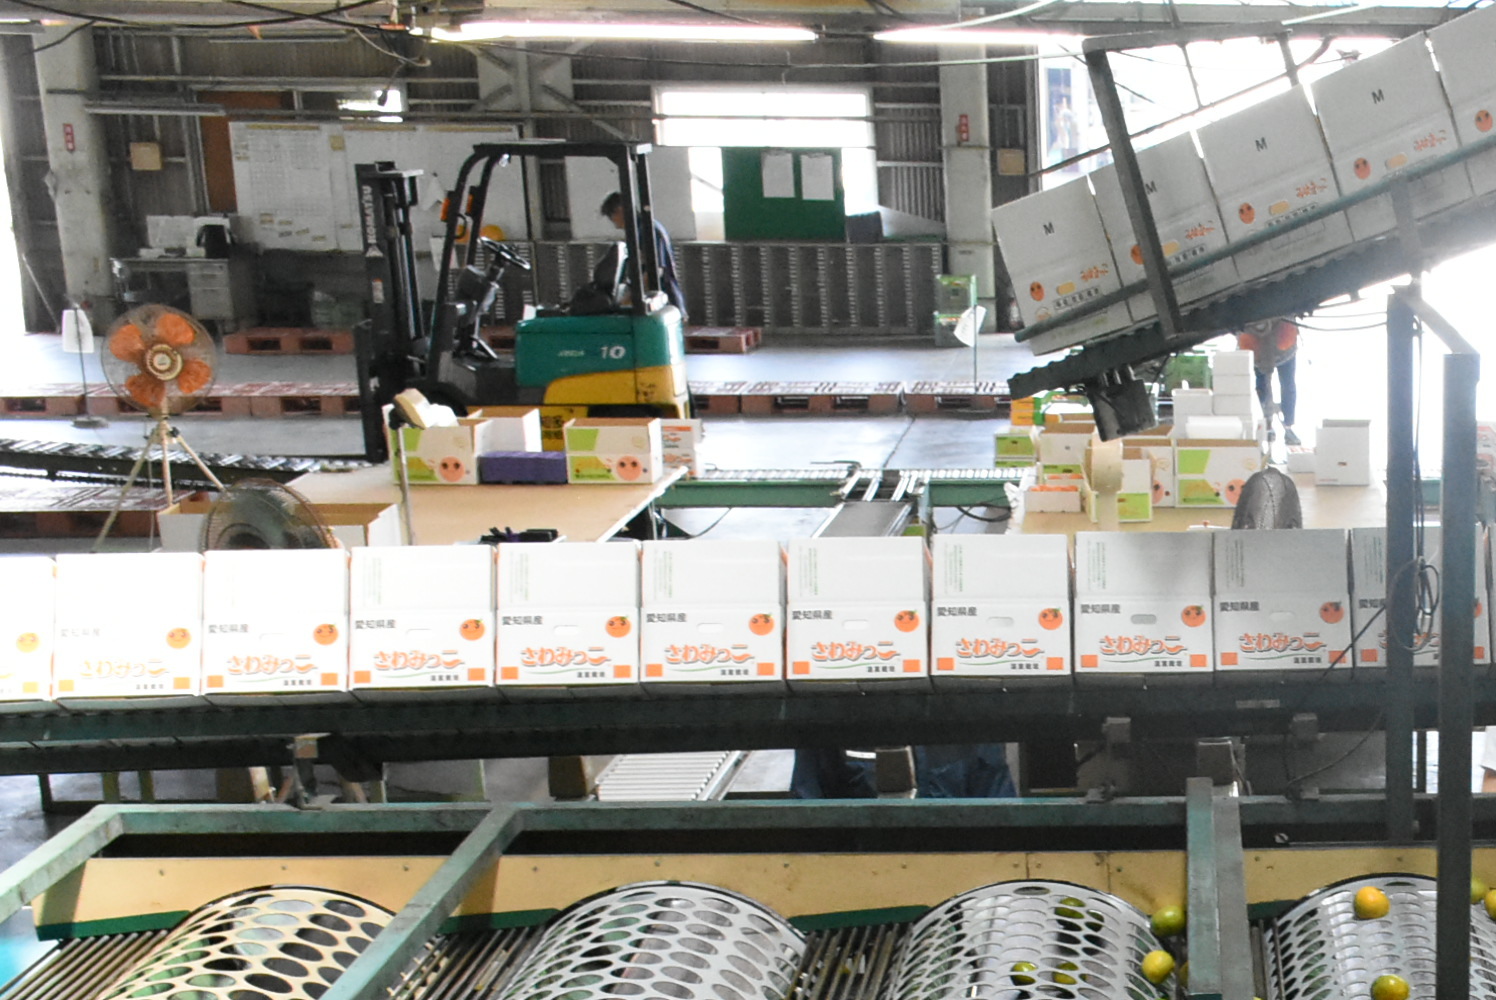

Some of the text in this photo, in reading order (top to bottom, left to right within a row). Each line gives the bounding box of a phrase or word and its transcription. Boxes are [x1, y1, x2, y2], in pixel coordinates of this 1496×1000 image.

[1371, 89, 1385, 104] M
[1255, 137, 1268, 152] M
[1145, 181, 1158, 195] M
[1043, 222, 1056, 236] M
[600, 345, 626, 360] 10
[937, 606, 978, 617] 愛知県産
[1080, 603, 1121, 614] 愛知県産
[1219, 601, 1260, 612] 愛知県産
[502, 615, 543, 626] 愛知県産
[646, 612, 687, 623] 愛知県産
[792, 610, 833, 620] 愛知県産
[355, 619, 396, 630] 愛知県産
[956, 637, 1045, 659] さわみっこ
[1100, 635, 1188, 657] さわみっこ
[1239, 632, 1327, 653] さわみっこ
[521, 646, 612, 668] さわみっこ
[665, 642, 755, 665] さわみっこ
[812, 640, 901, 662] さわみっこ
[228, 653, 319, 676] さわみっこ
[374, 649, 465, 671] さわみっこ
